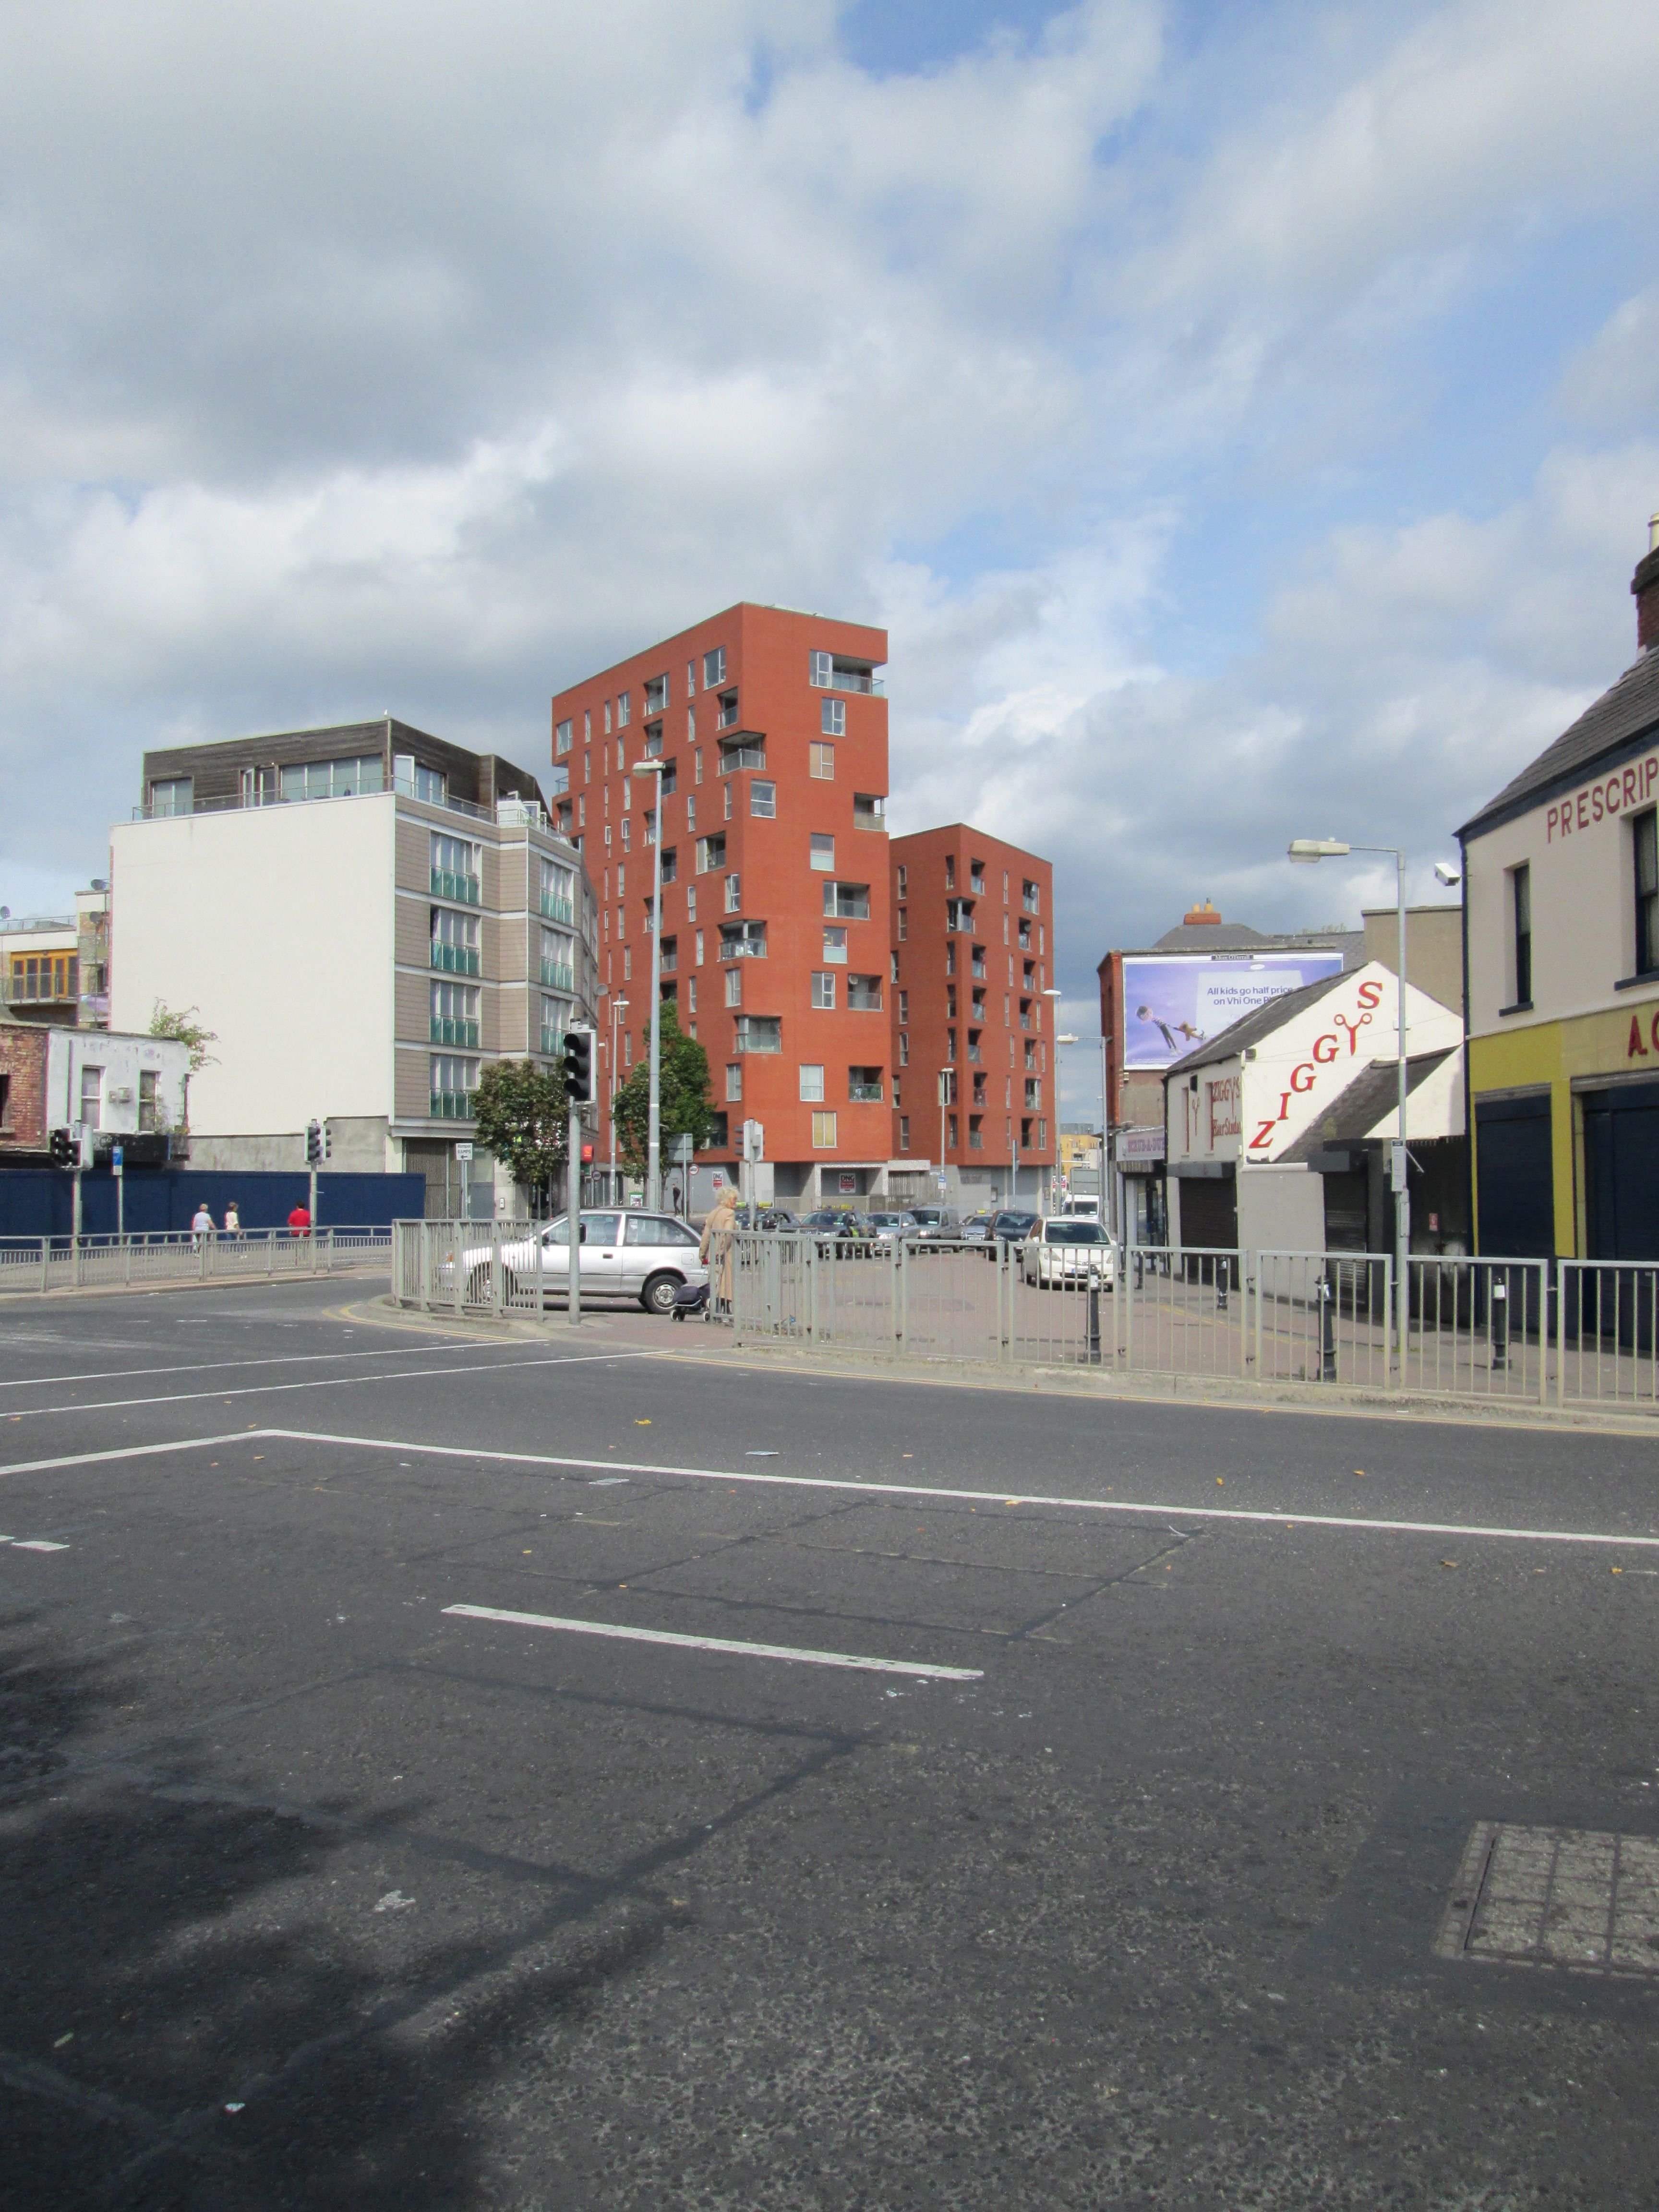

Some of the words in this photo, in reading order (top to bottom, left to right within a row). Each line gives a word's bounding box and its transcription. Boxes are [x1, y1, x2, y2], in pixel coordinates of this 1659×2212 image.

[1547, 757, 1659, 844] PRESCRIP
[1207, 987, 1219, 995] All
[1239, 988, 1250, 997] go
[1252, 986, 1270, 995] half
[1270, 986, 1293, 995] price
[1226, 997, 1242, 1005] Vhi
